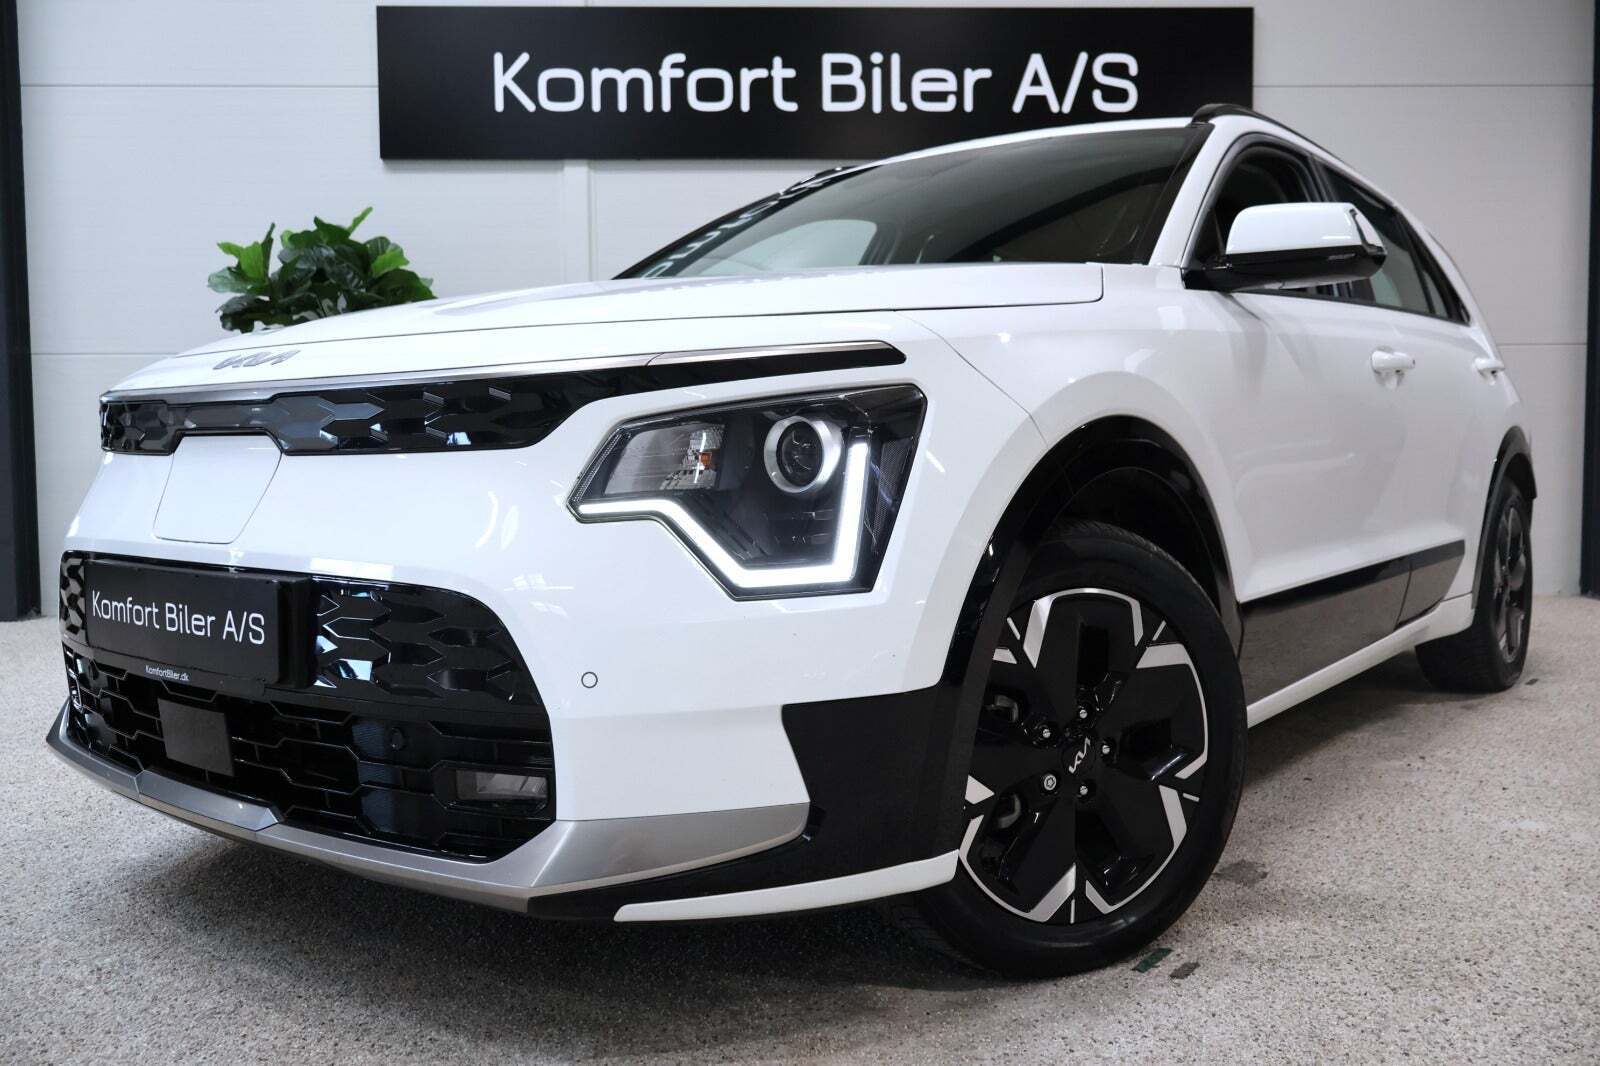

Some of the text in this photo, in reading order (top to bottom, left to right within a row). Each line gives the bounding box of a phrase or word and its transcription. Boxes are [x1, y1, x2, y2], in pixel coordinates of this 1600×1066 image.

[494, 52, 1138, 113] Komfort Biler A/S
[92, 589, 266, 646] Komfort Biler A/S
[145, 664, 190, 682] KomfortBiler.dk
